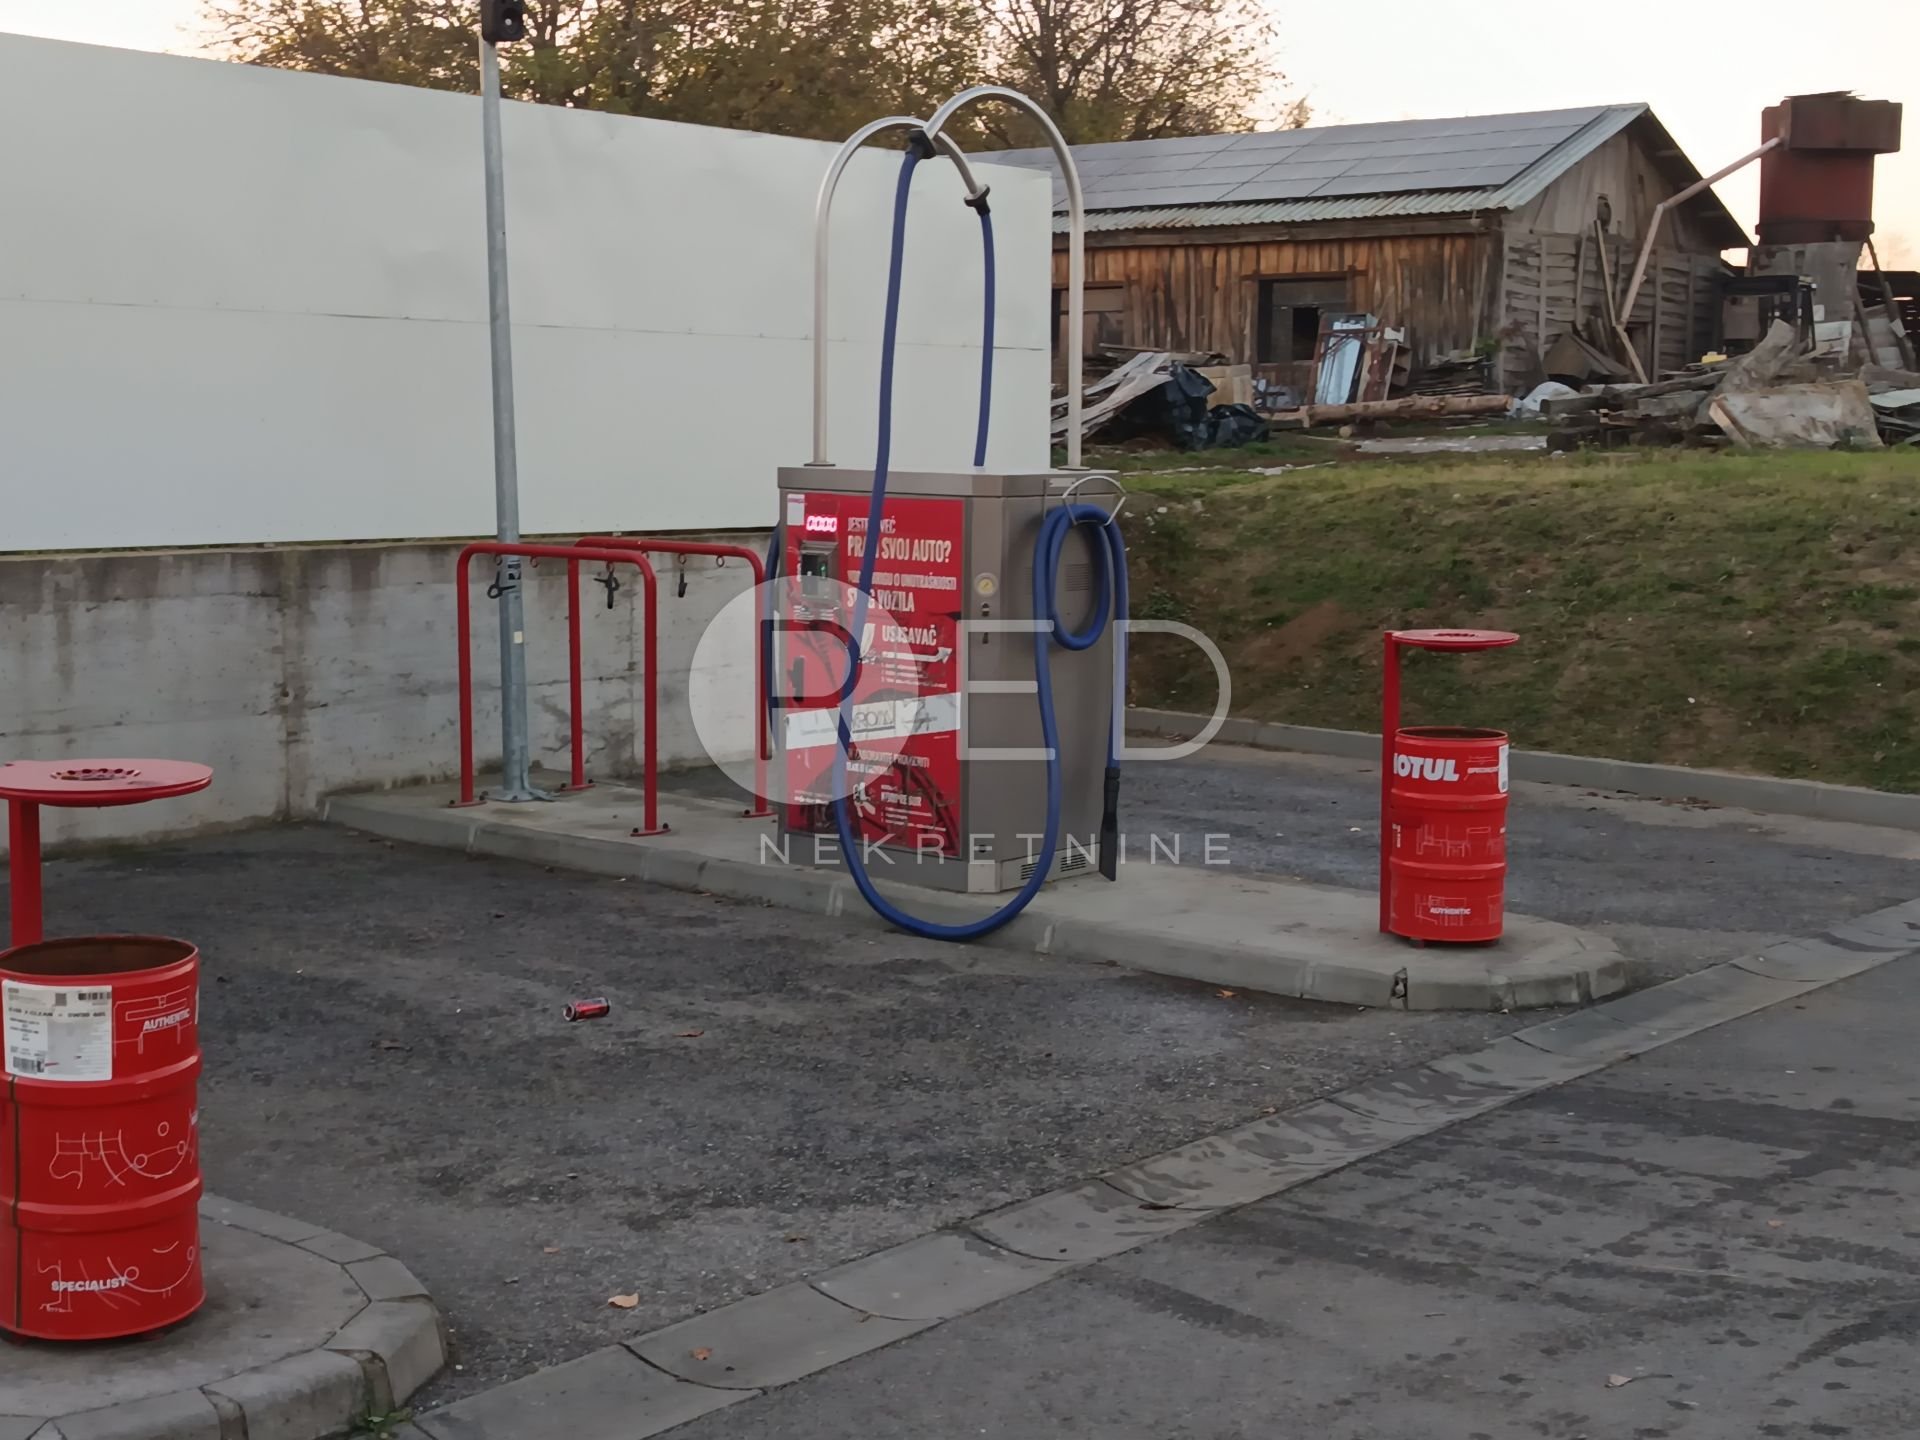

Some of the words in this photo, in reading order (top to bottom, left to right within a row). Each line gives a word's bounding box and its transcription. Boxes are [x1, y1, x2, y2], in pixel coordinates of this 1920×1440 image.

[881, 536, 910, 560] SVOJ
[912, 539, 952, 563] AUTO?
[877, 589, 915, 613] VOZILA
[1393, 753, 1460, 782] OTUL
[143, 1008, 191, 1031] AUTHENTIC
[51, 1275, 129, 1292] SPECIALIST
